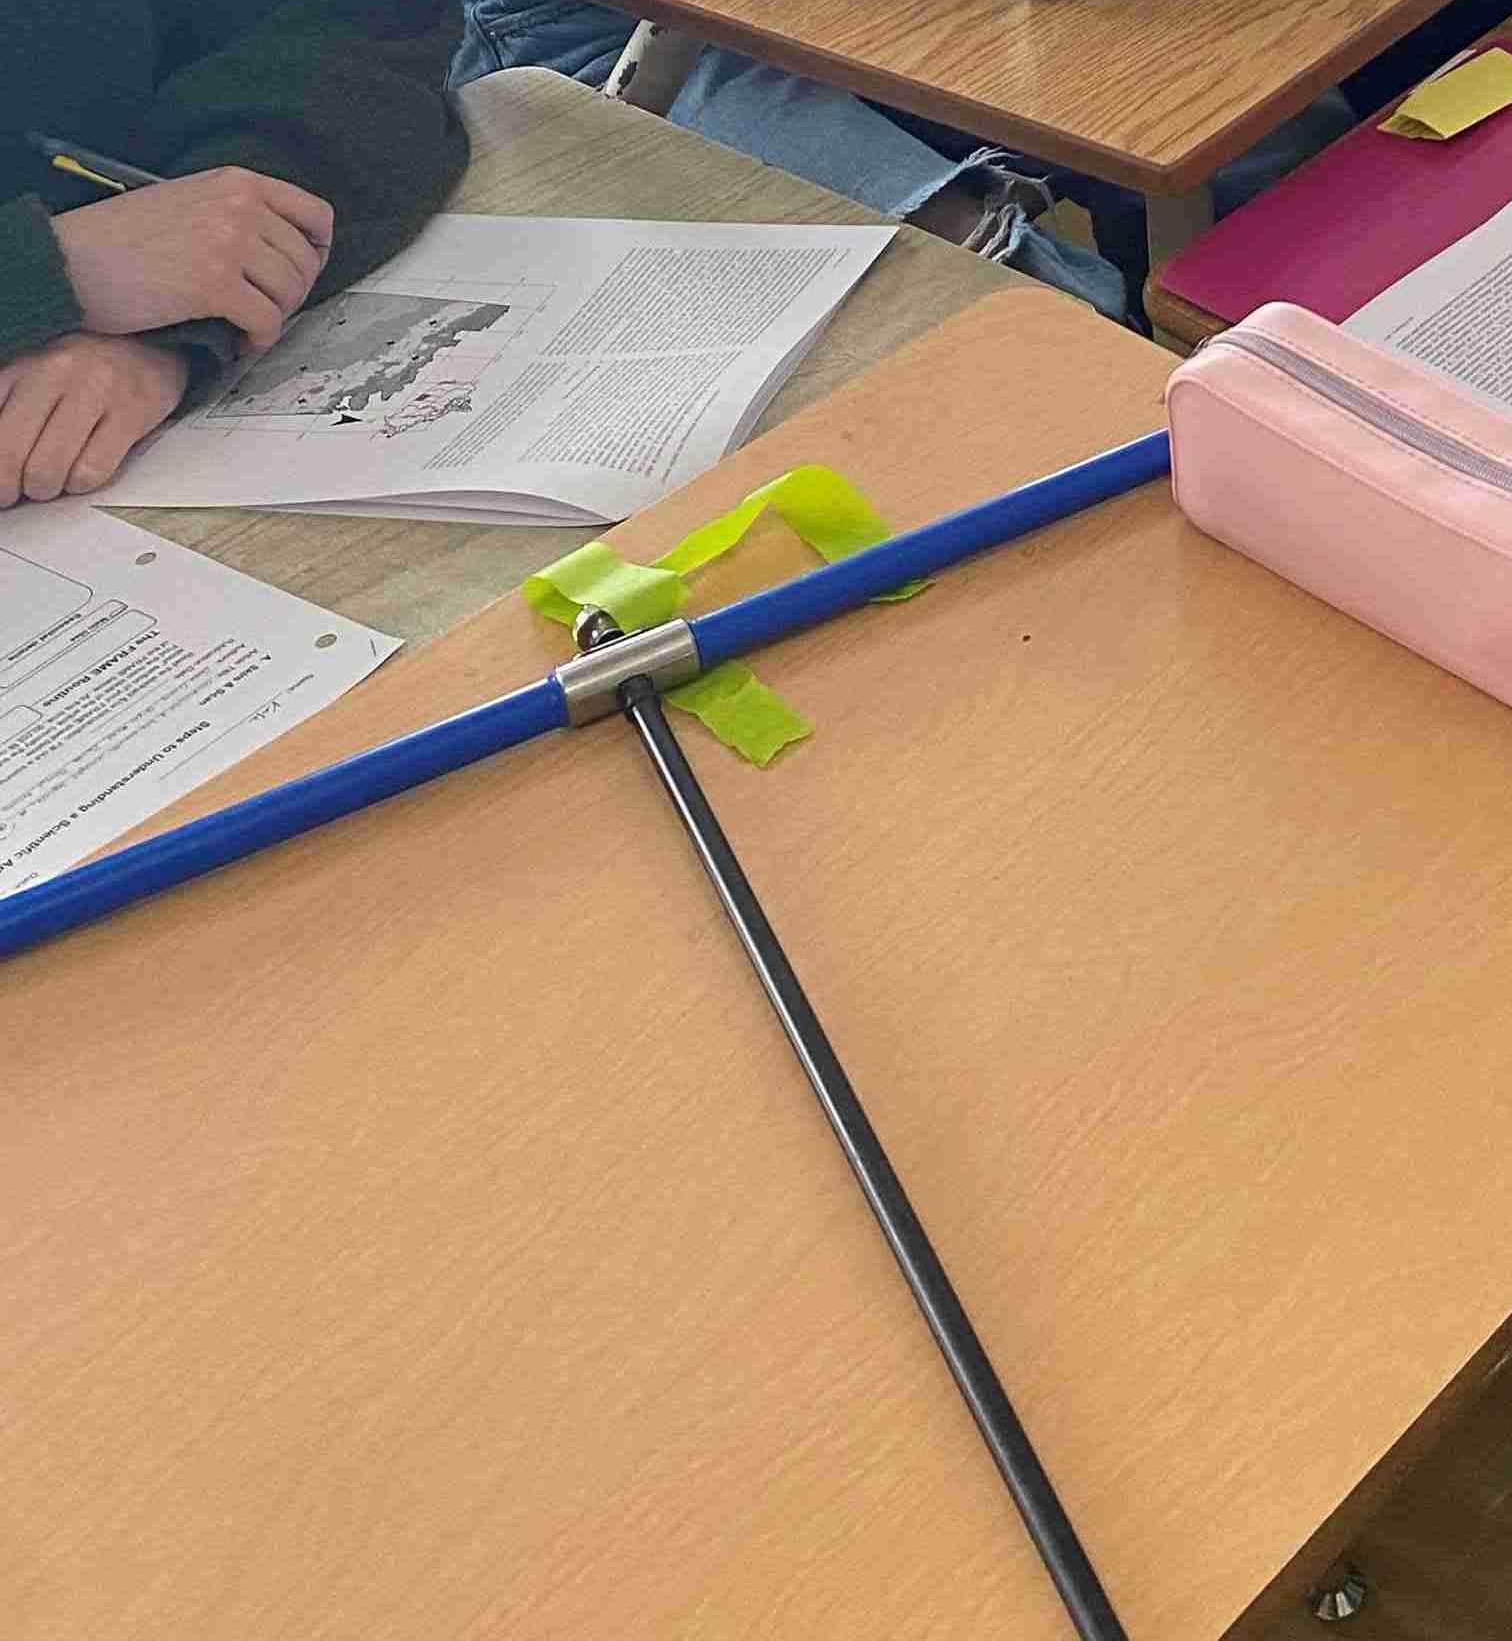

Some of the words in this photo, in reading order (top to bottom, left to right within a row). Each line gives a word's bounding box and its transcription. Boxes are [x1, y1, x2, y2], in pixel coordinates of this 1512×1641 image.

[88, 644, 138, 677] FRAME
[40, 674, 92, 709] Routine
[171, 718, 212, 747] Steps
[75, 750, 166, 815] Understanding
[11, 816, 71, 862] Scientific
